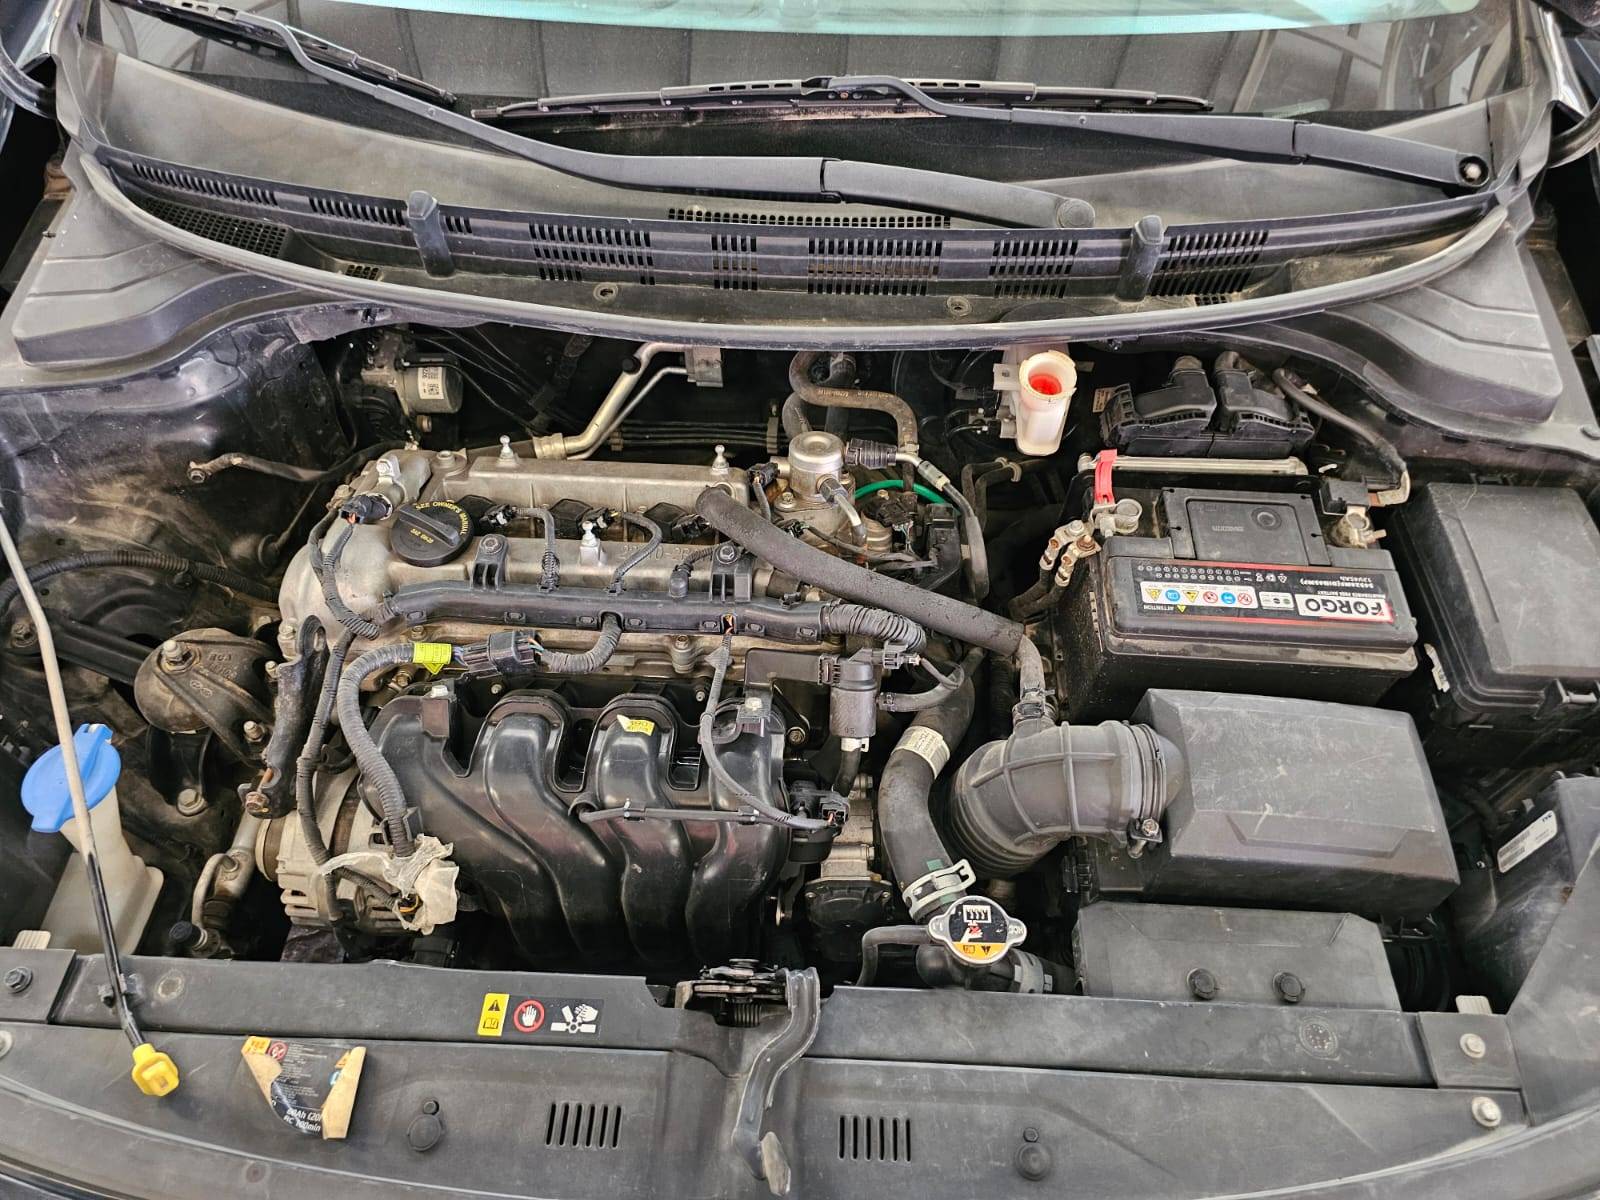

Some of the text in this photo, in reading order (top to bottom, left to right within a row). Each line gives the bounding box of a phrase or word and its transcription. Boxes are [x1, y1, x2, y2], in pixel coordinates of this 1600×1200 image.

[415, 502, 469, 535] SEE OWNER'S MANUAL
[1143, 604, 1175, 612] ATTENTION
[1305, 598, 1384, 616] FORGO
